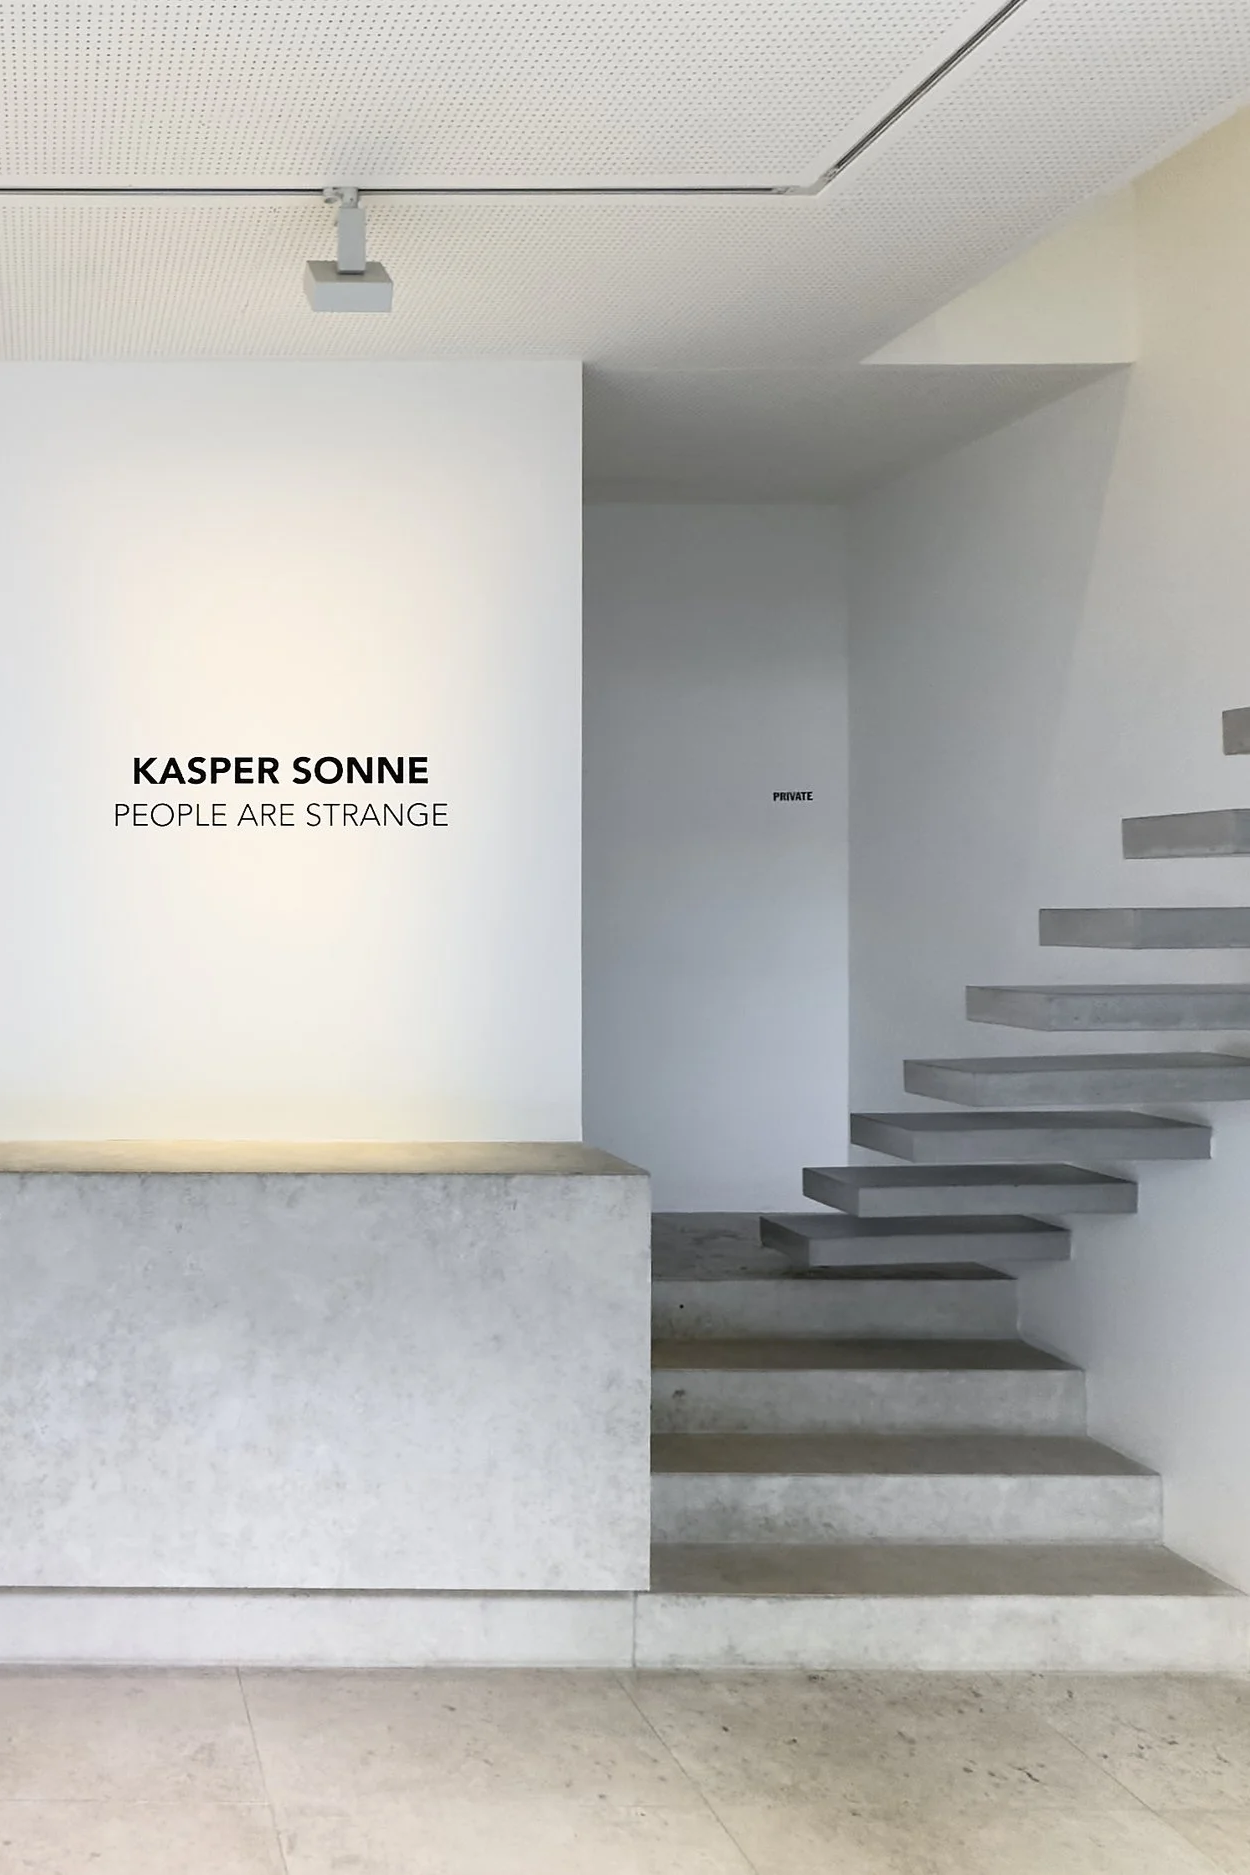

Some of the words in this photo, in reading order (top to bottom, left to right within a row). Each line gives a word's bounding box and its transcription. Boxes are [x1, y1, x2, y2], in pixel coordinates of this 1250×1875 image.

[133, 757, 279, 785] KASPER
[292, 756, 429, 785] SONNE
[773, 791, 814, 802] PRIVATE
[114, 803, 228, 828] PEOPLE
[236, 803, 296, 828] ARE
[306, 802, 449, 828] STRANGE
